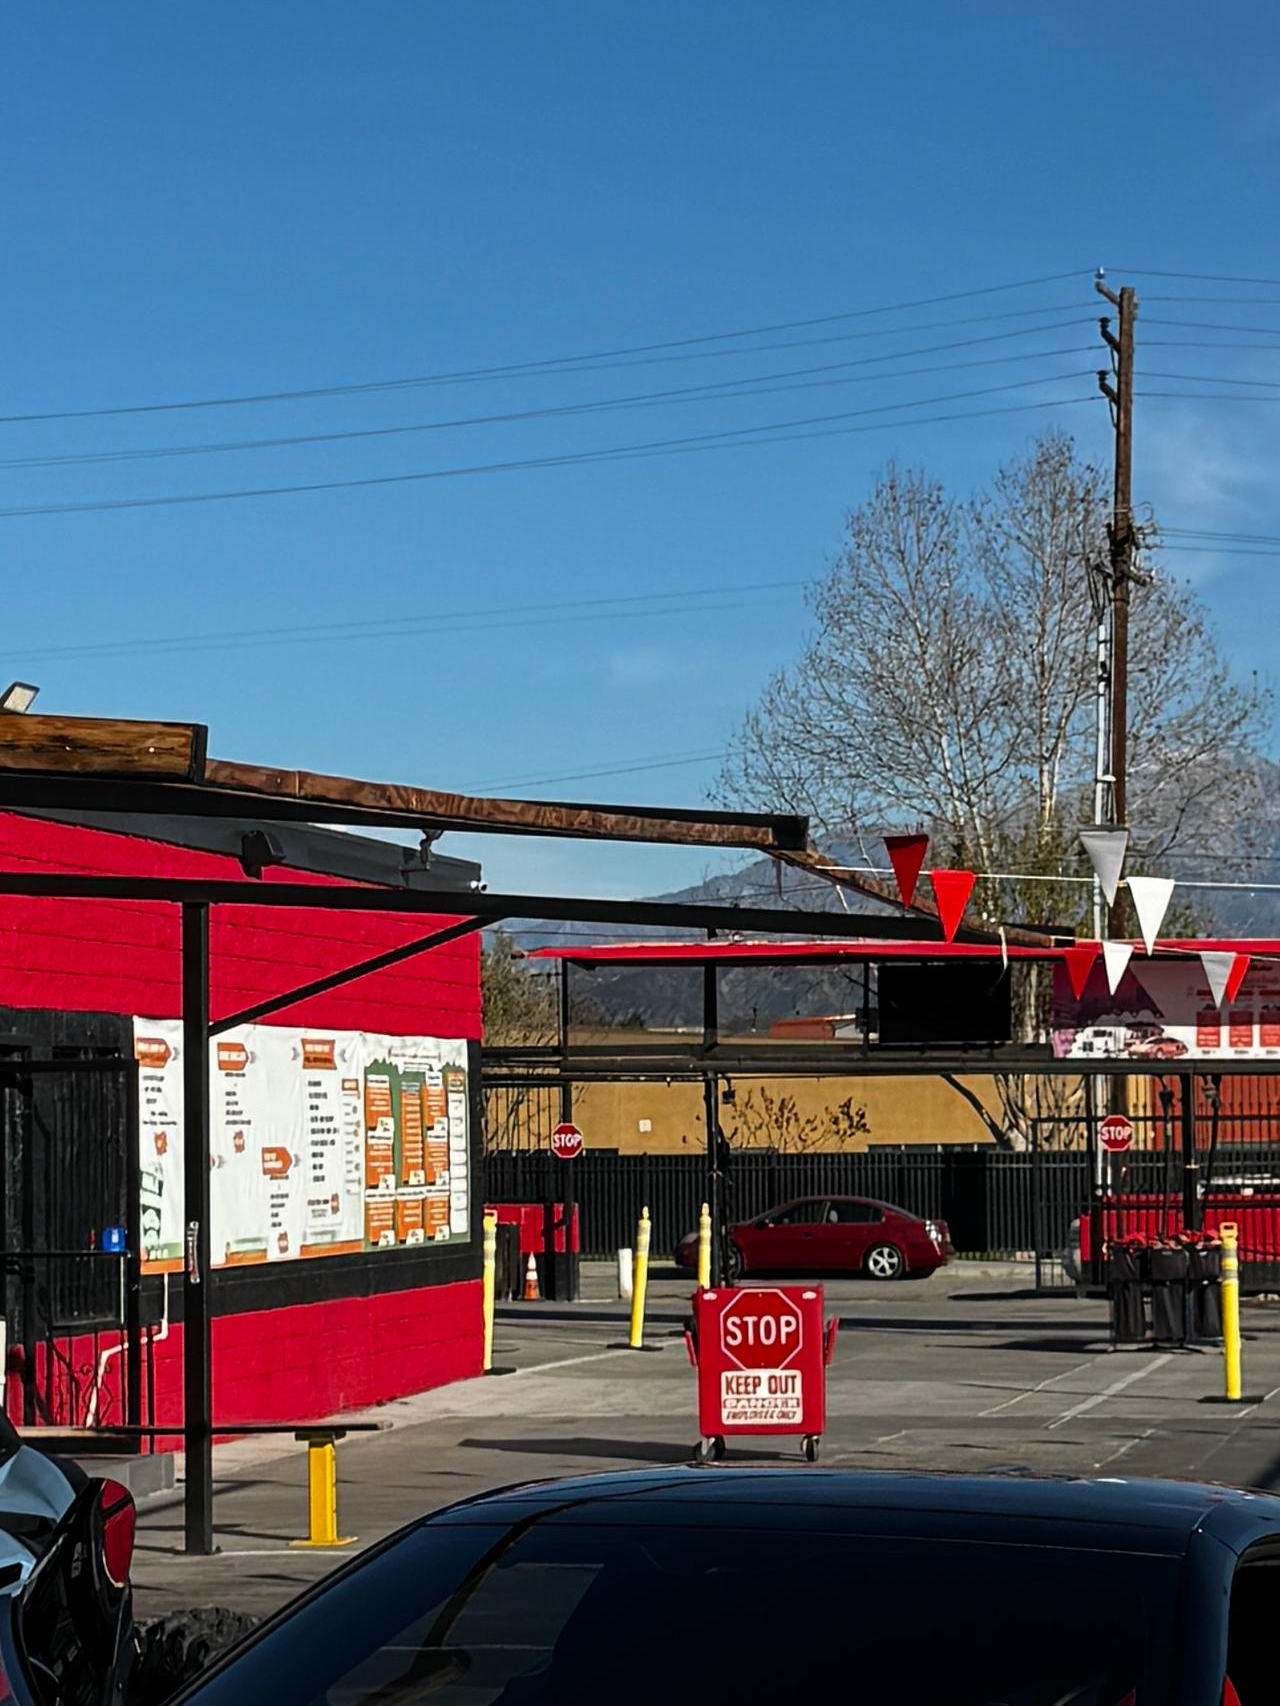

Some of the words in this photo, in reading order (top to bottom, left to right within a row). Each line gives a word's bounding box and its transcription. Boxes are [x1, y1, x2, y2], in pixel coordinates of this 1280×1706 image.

[553, 1134, 582, 1147] STOP
[1101, 1126, 1132, 1140] STOP
[726, 1315, 797, 1345] STOP
[725, 1375, 762, 1395] KEEP
[768, 1375, 797, 1394] OUT
